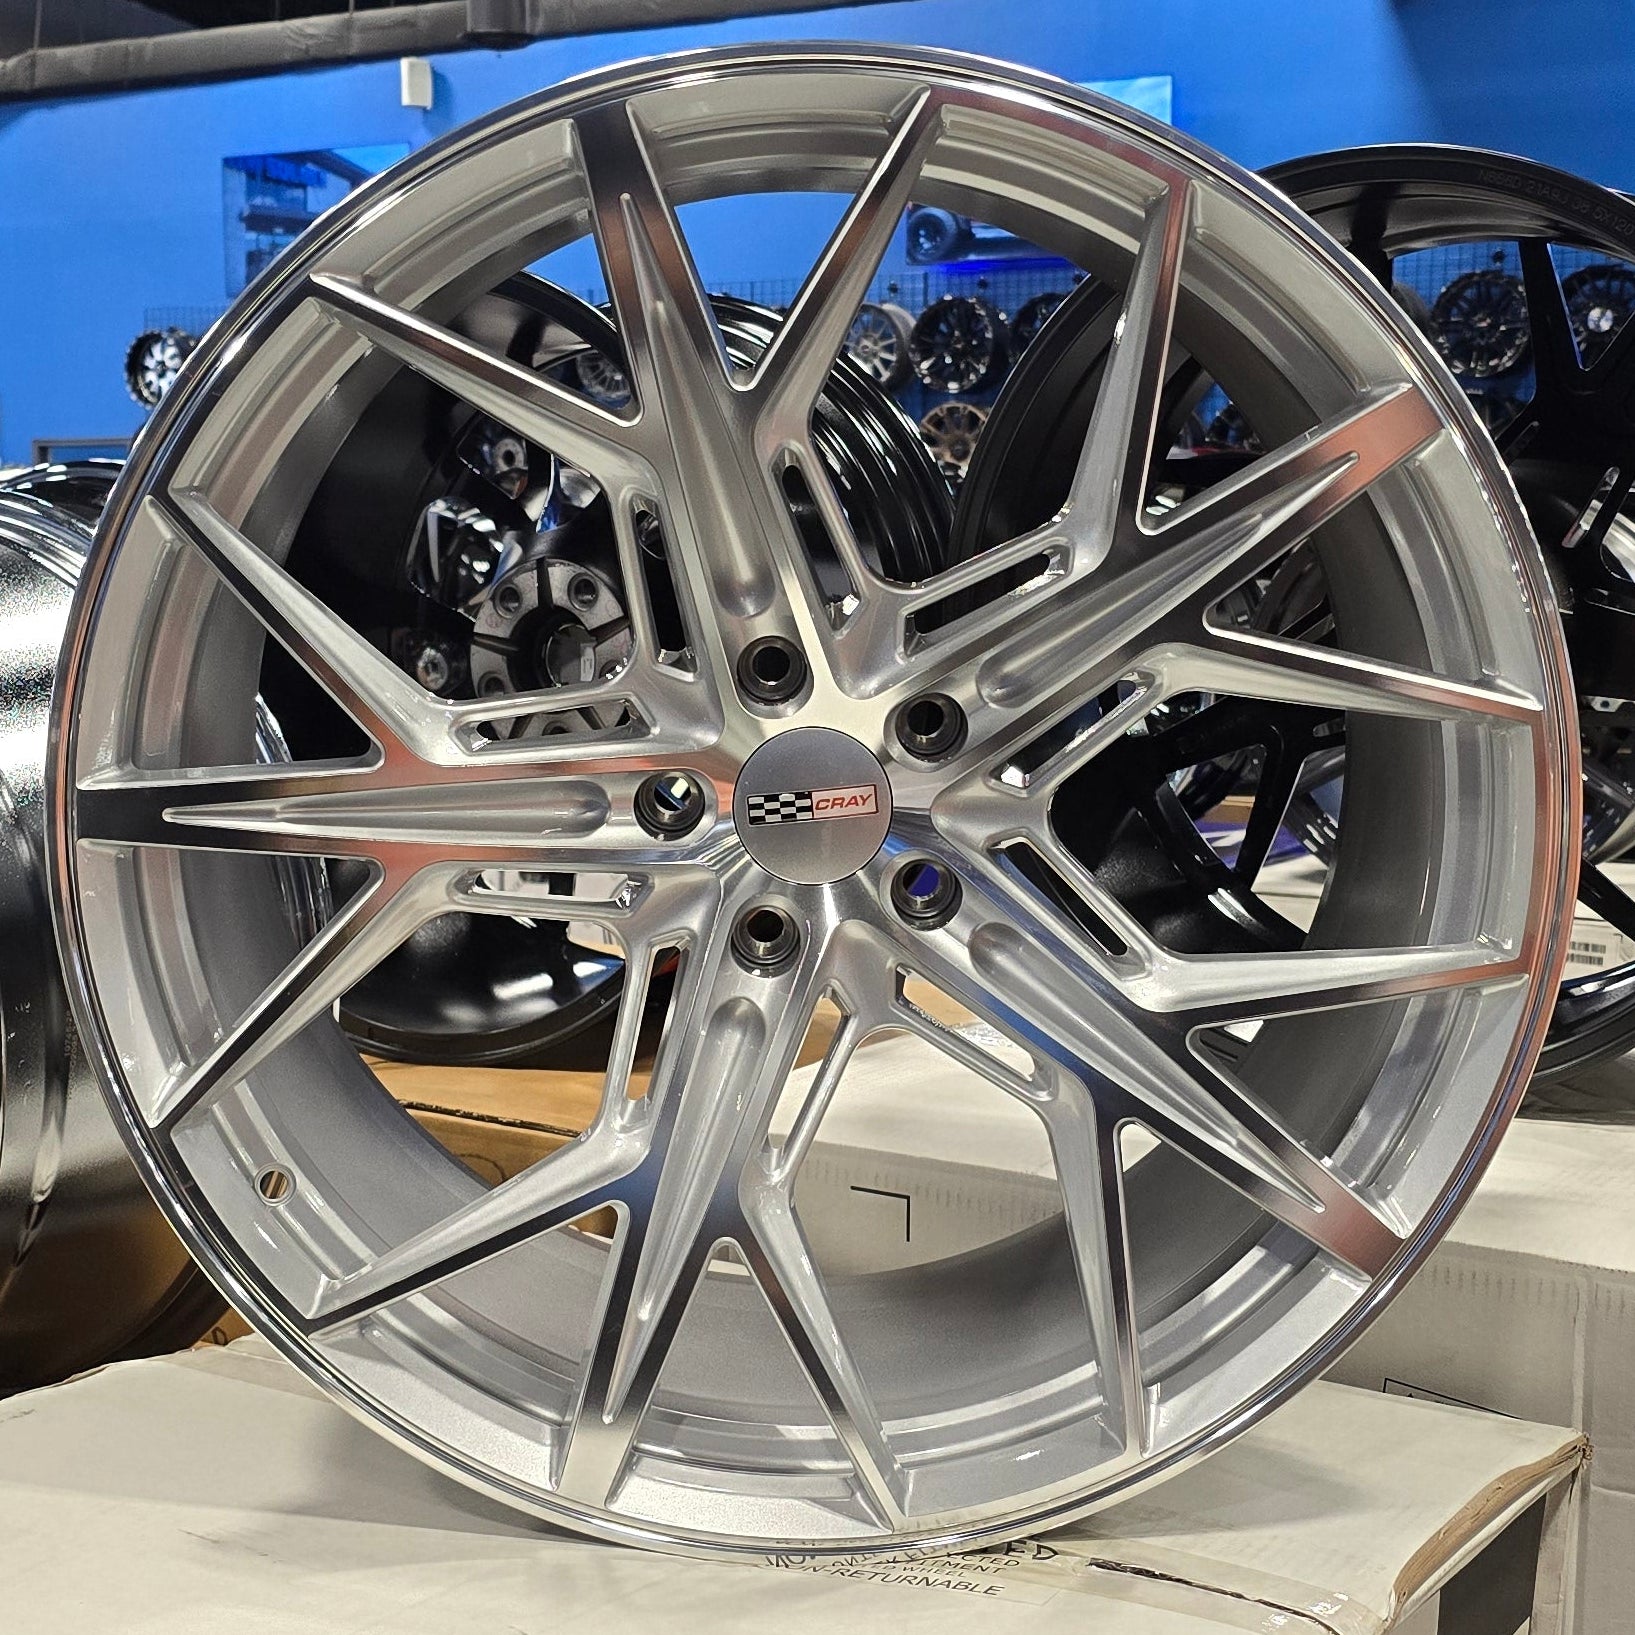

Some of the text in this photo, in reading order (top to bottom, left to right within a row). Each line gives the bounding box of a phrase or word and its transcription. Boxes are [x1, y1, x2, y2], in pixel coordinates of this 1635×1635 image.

[815, 793, 873, 811] CRAY
[917, 1560, 1007, 1574] ITMENT
[786, 1564, 1006, 1596] N-RETURNABLE
